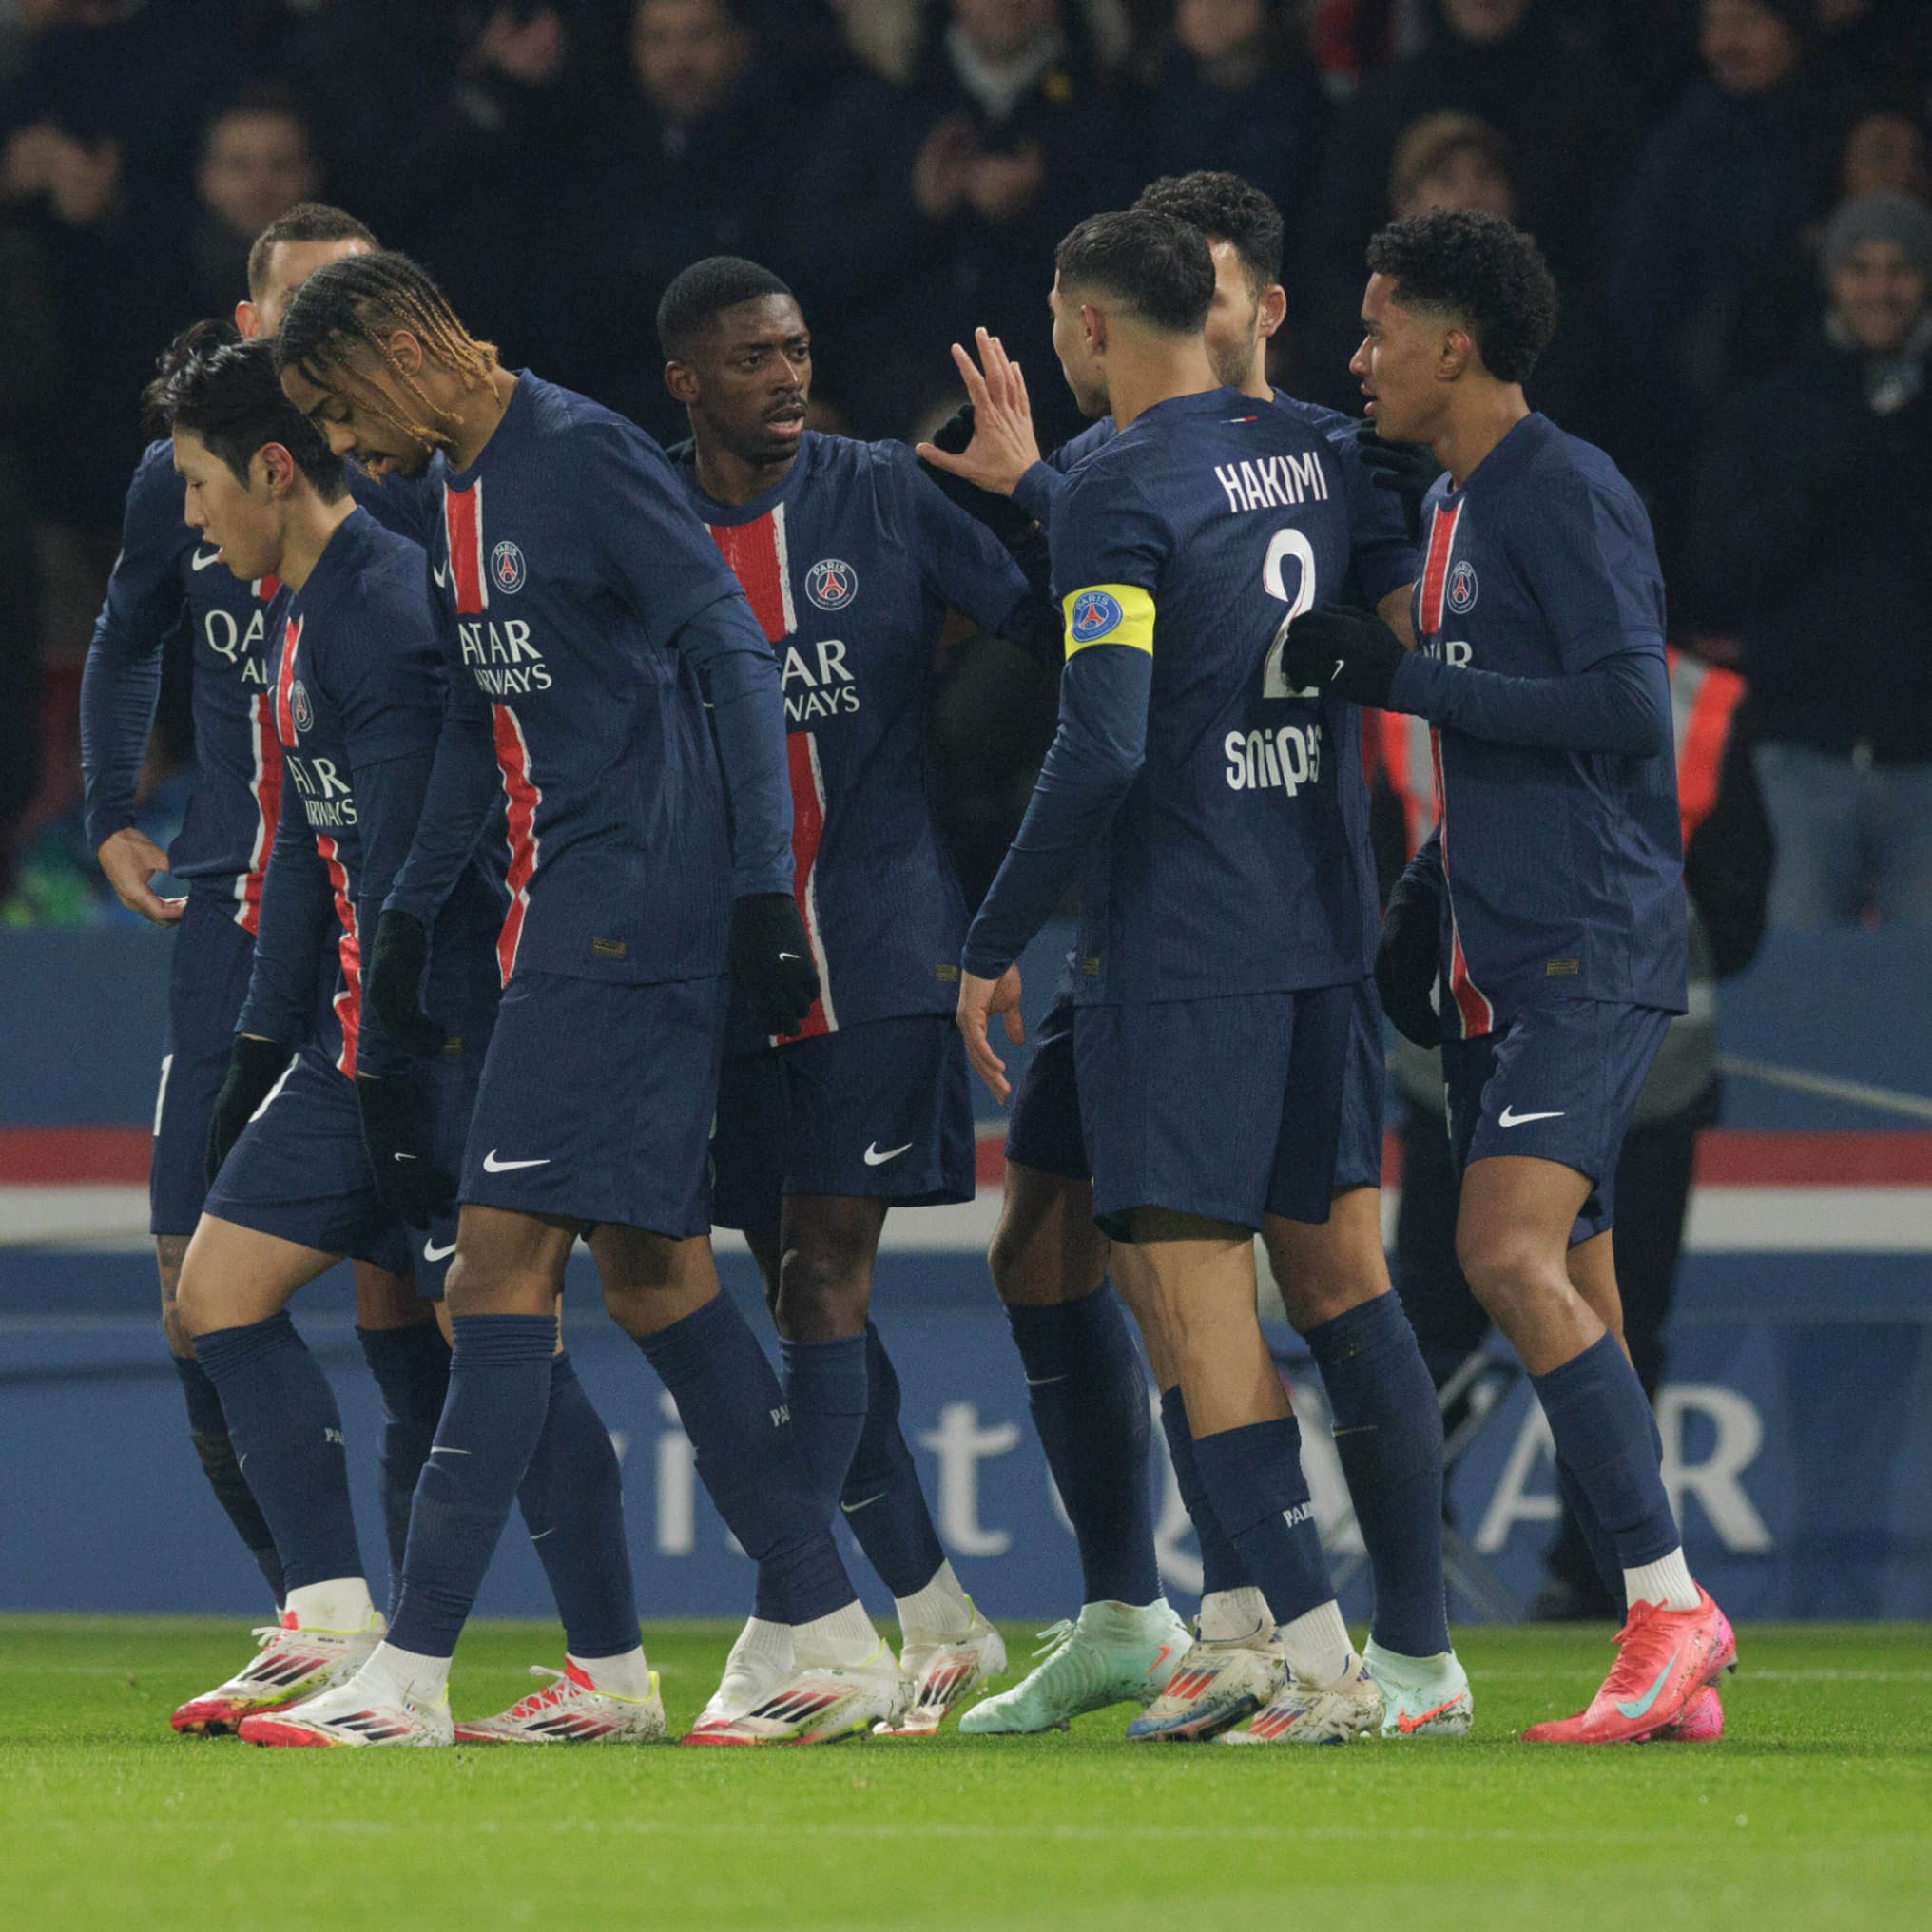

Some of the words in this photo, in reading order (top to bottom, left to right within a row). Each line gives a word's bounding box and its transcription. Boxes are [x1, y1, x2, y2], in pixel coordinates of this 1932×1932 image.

[1214, 451, 1329, 512] HAKIMI
[813, 561, 847, 576] PARIS
[1263, 528, 1316, 698] 2
[771, 639, 855, 691] AR
